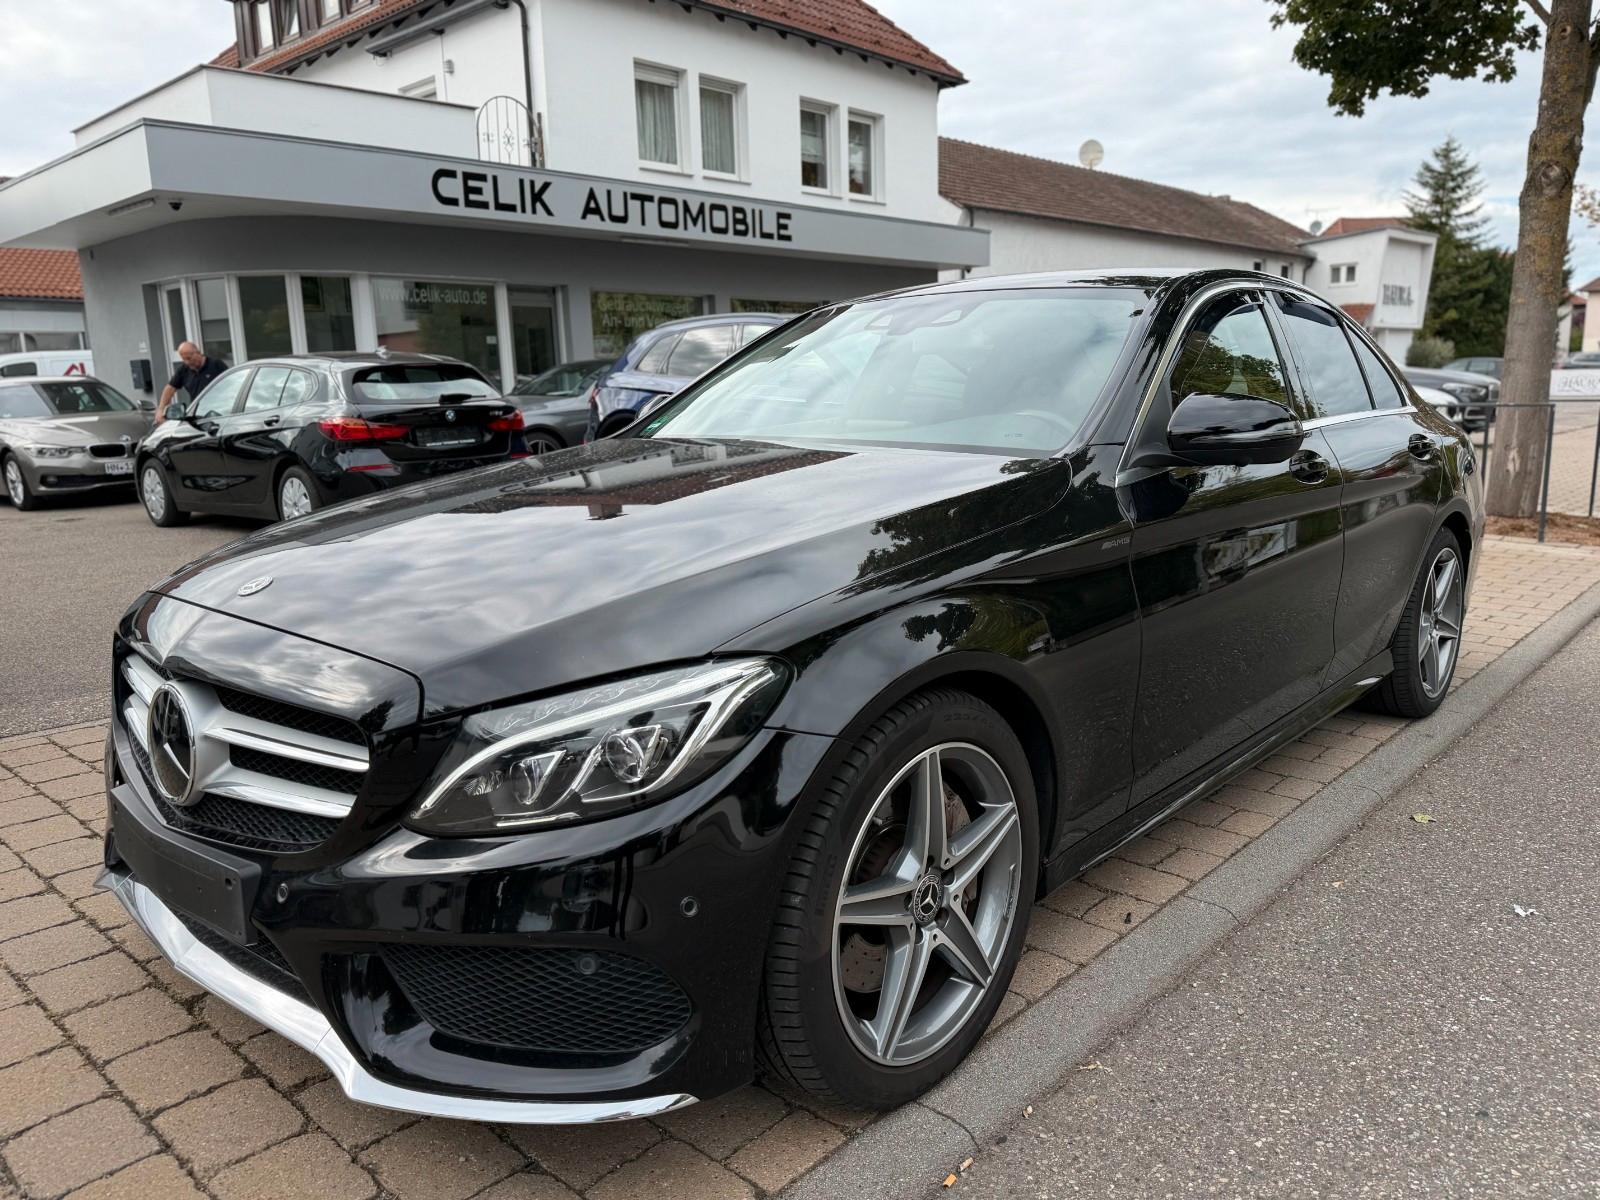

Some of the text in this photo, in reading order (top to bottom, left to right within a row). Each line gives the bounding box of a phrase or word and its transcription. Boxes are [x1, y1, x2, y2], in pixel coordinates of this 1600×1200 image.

[431, 167, 793, 242] CELIK AUTOMOBILE
[378, 286, 488, 305] www.celik-auto.de
